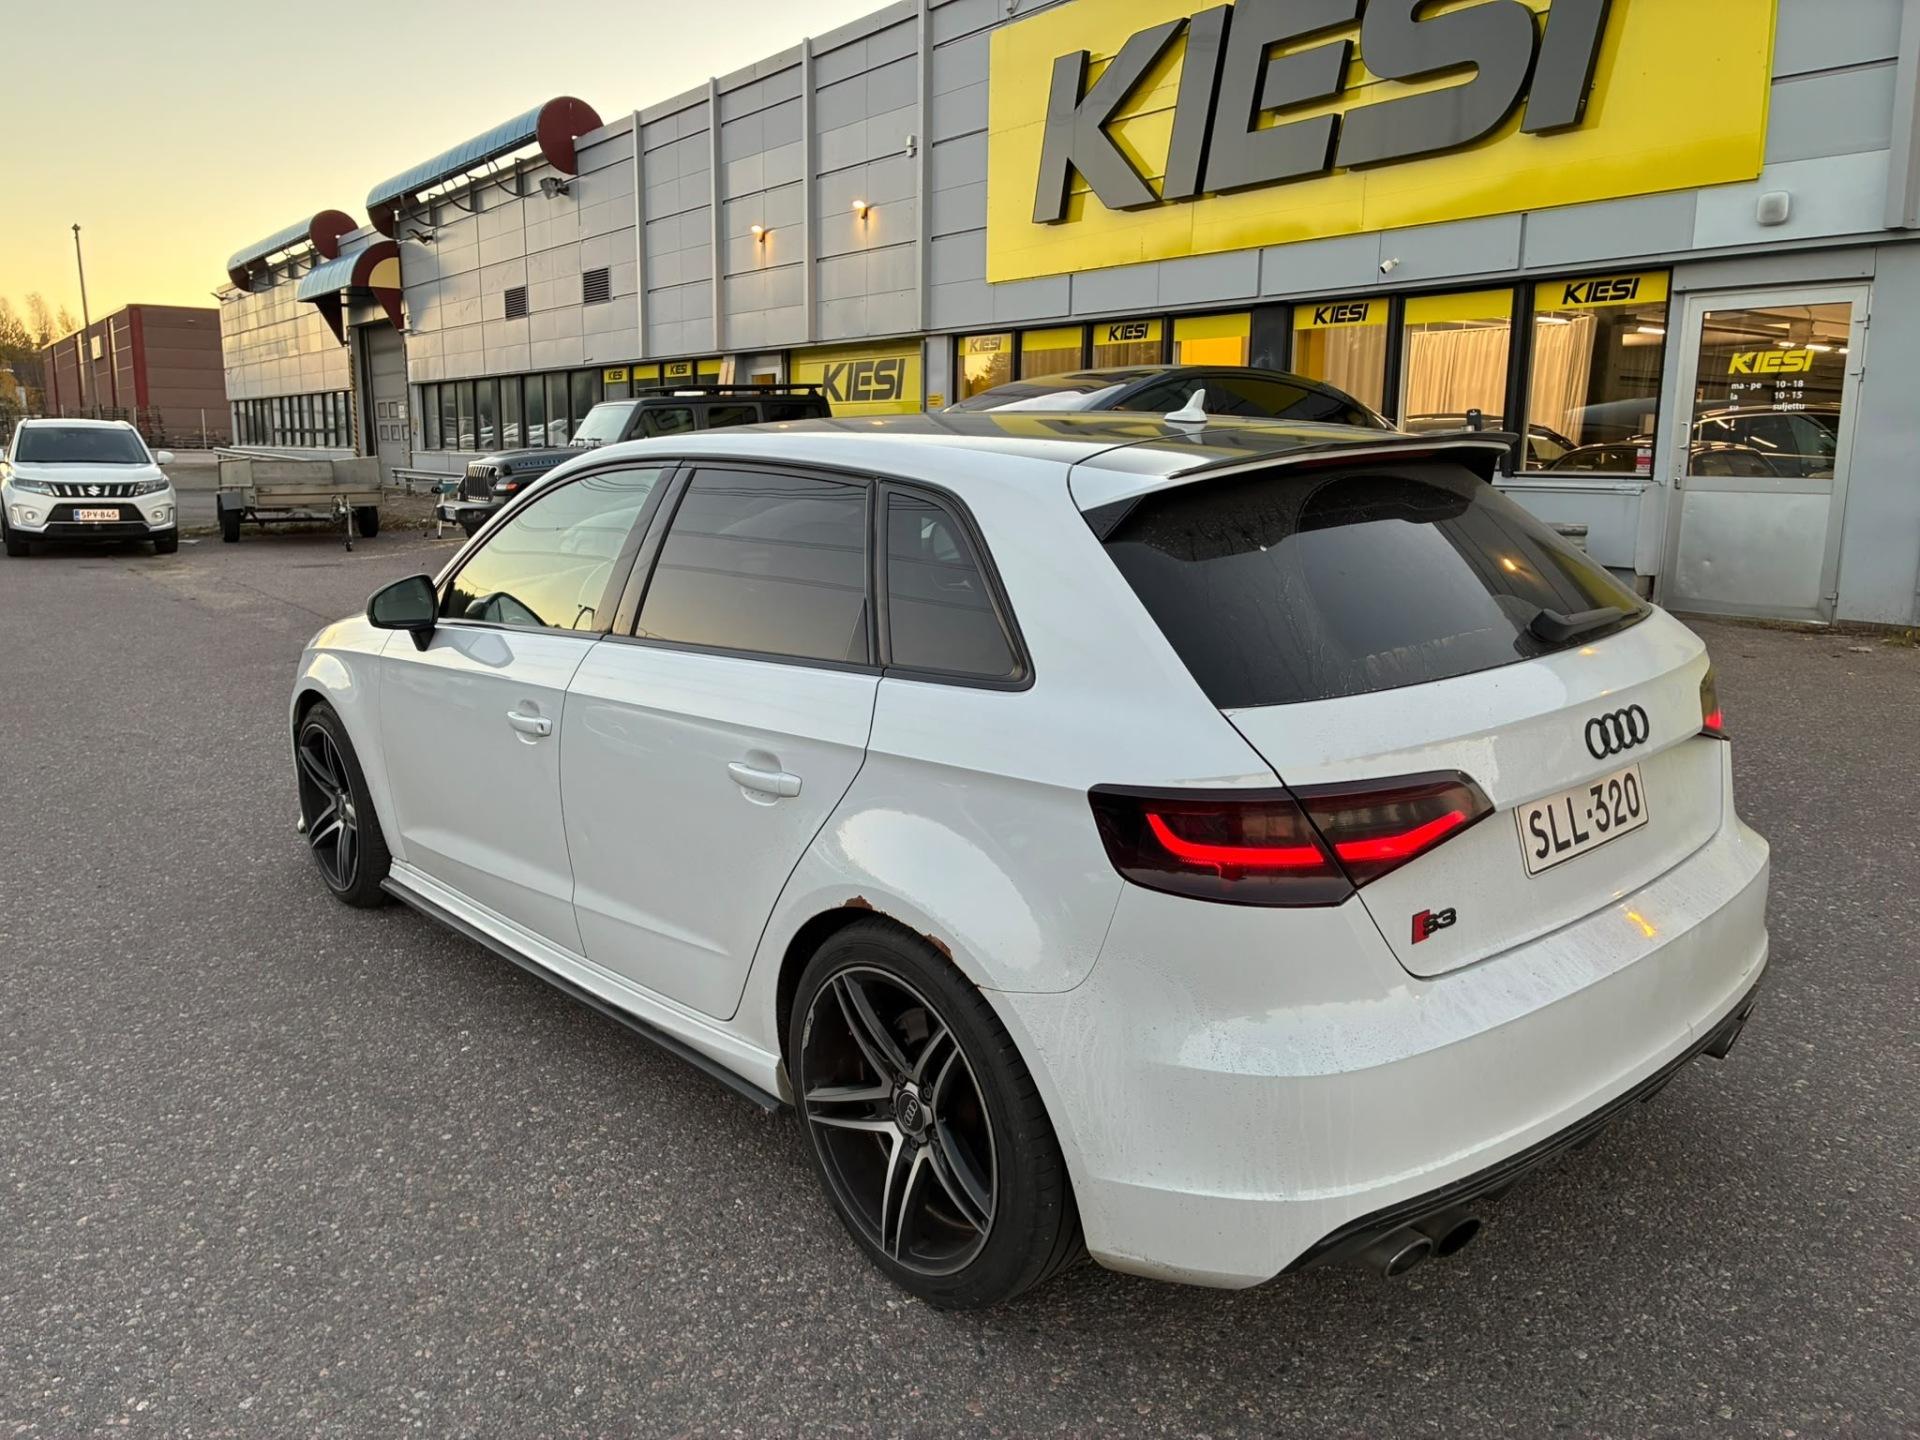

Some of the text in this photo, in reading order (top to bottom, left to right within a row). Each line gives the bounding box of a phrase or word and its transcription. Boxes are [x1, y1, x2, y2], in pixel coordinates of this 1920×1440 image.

[1032, 0, 1612, 224] KIESI
[1562, 277, 1640, 305] KIESI
[1313, 303, 1370, 325] KIESI
[1108, 322, 1149, 342] KIESI
[969, 336, 1002, 352] KIESI
[1728, 349, 1815, 374] KIESI
[822, 358, 905, 401] KIESI
[1775, 380, 1786, 388] 10
[1793, 380, 1804, 388] 18
[1792, 391, 1803, 399] 15
[1772, 402, 1805, 412] suljettu
[1529, 772, 1641, 859] SLL-320
[1423, 907, 1457, 936] S3
